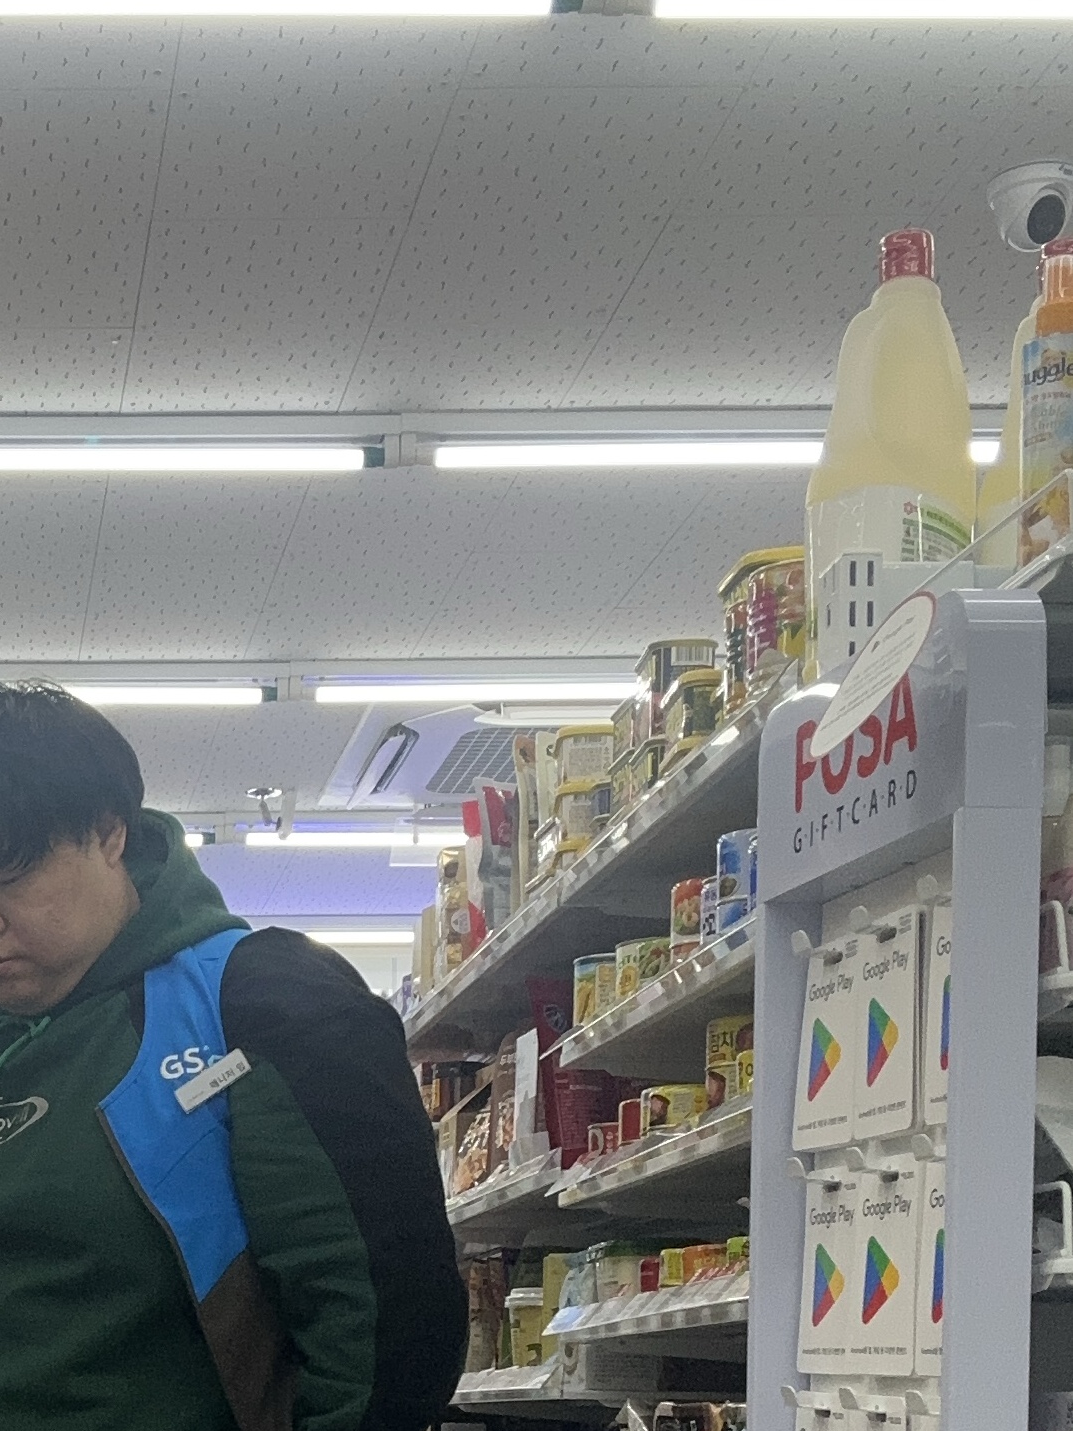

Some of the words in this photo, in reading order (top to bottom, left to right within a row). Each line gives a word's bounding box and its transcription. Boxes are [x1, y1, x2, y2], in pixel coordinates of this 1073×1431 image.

[863, 957, 891, 981] Google
[892, 950, 910, 971] Play
[808, 979, 836, 1001] Google
[837, 973, 855, 993] Play
[810, 1206, 837, 1229] Google
[838, 1204, 855, 1226] Play
[862, 1197, 891, 1221] Google
[892, 1195, 912, 1217] Play
